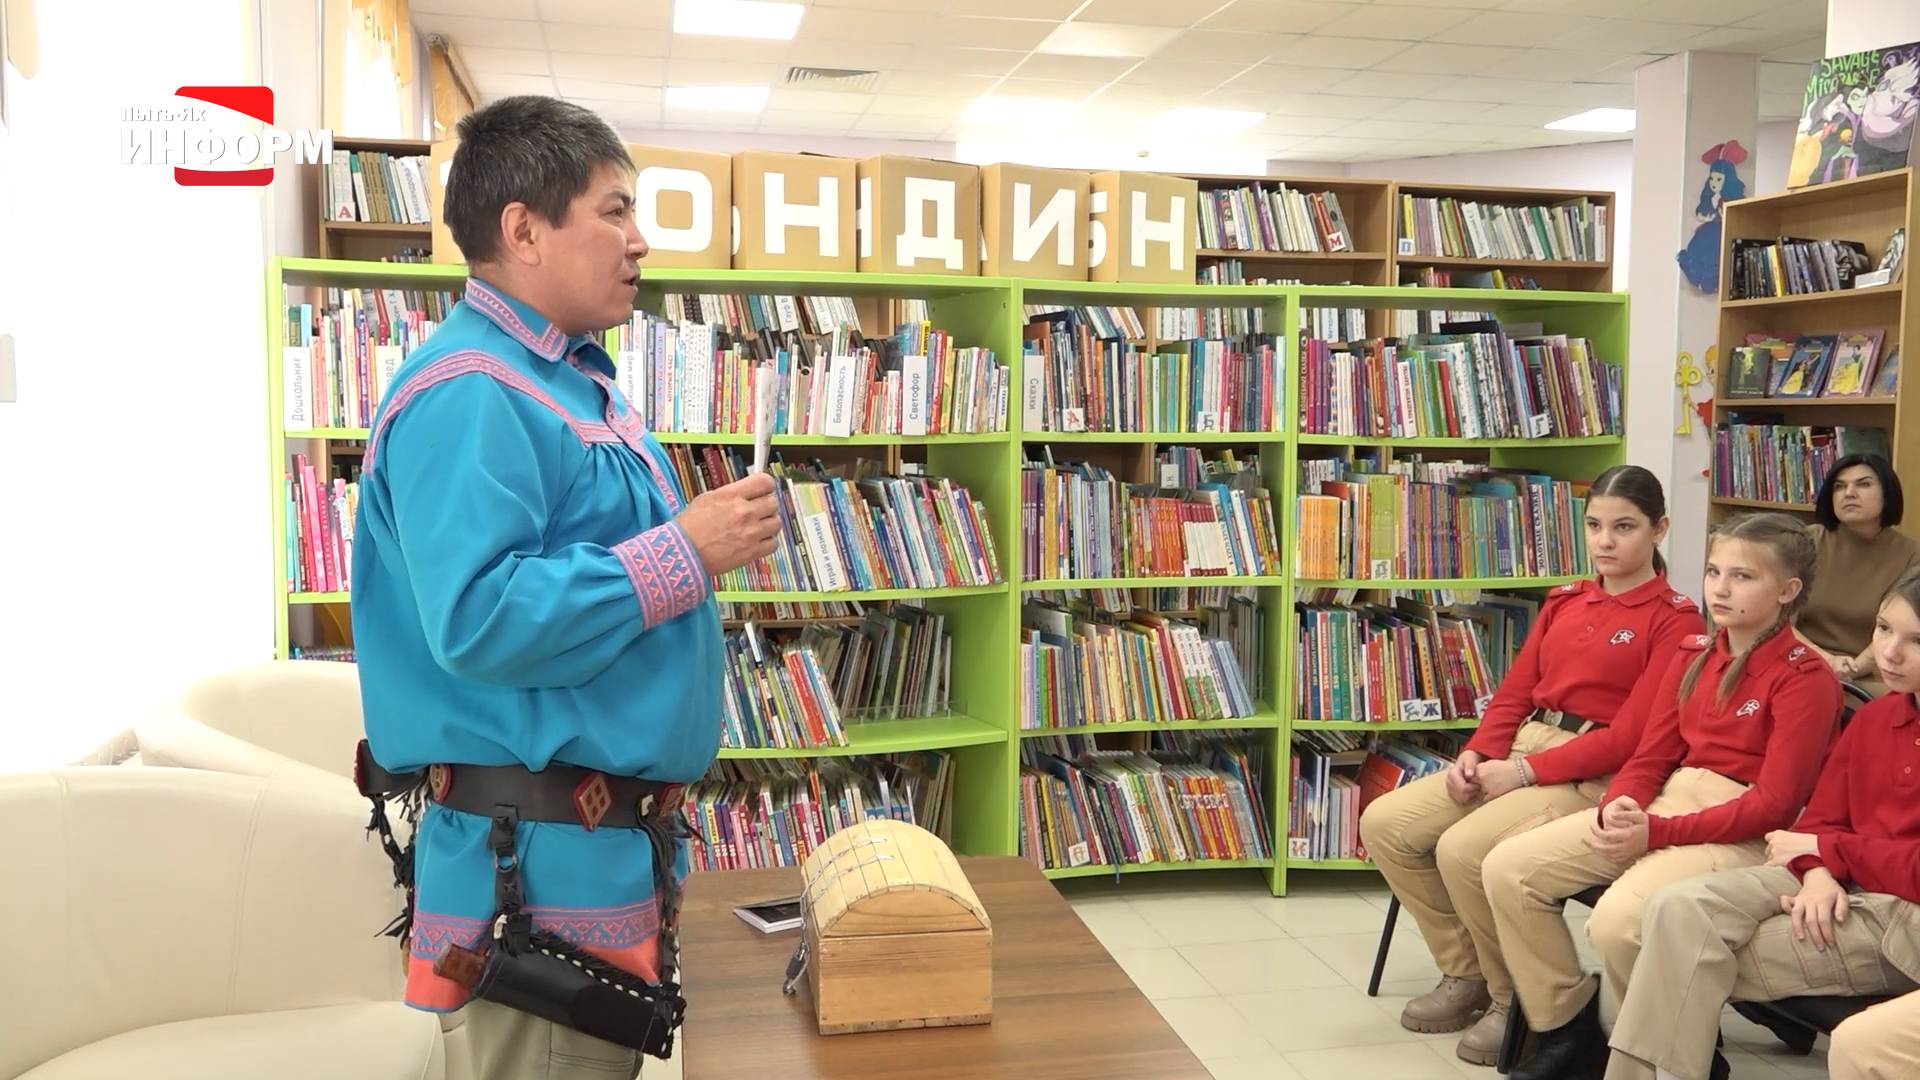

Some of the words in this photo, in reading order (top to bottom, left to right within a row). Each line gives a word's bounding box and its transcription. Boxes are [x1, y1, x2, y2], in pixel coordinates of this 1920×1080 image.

[292, 357, 305, 421] Дошкольник
[833, 366, 846, 423] Безопасность
[909, 374, 919, 419] Светофор
[1029, 378, 1038, 410] Сказки
[811, 517, 828, 554] познавай
[823, 562, 836, 586] Играй
[1424, 703, 1439, 717] Ж
